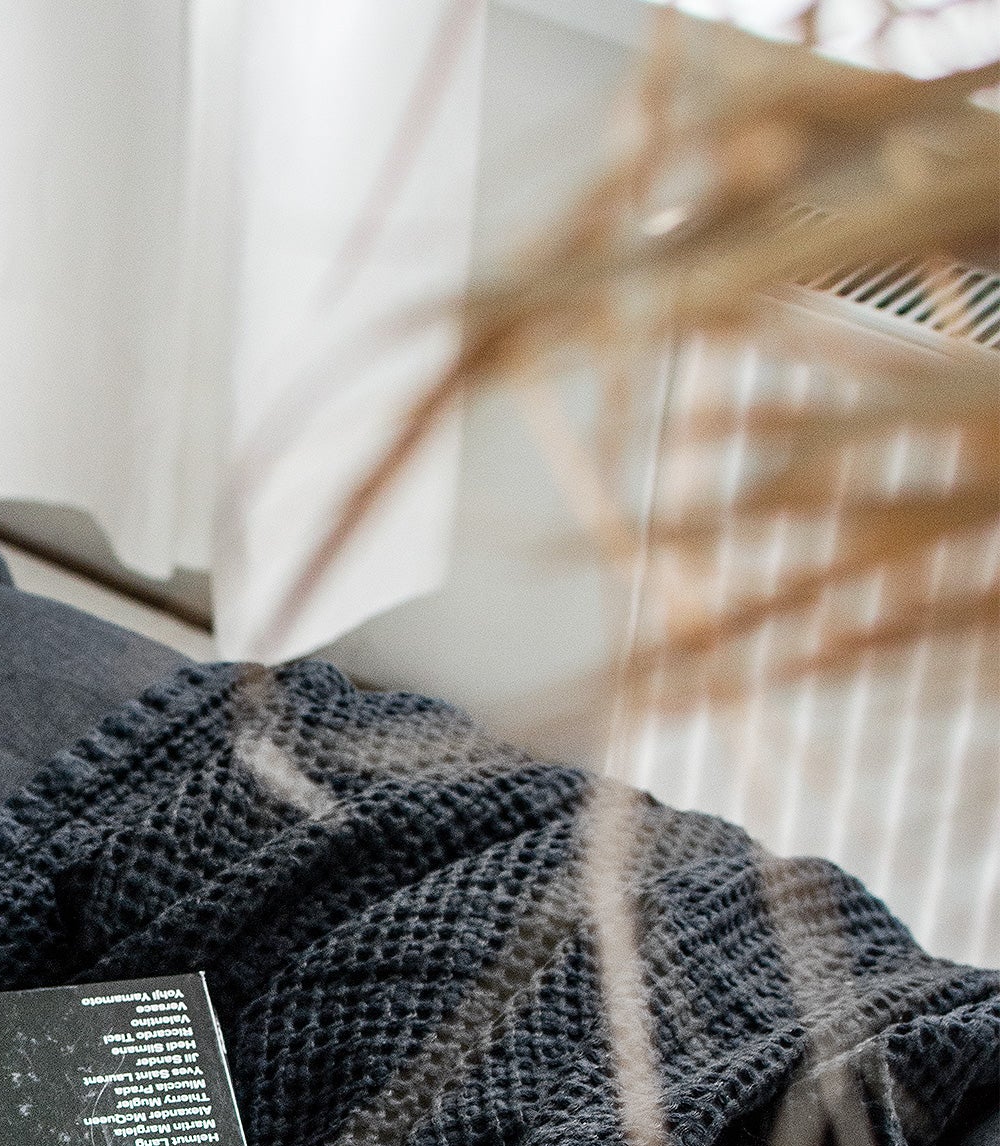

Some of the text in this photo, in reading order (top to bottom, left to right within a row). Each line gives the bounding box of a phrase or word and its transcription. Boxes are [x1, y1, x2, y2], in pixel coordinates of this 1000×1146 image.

[80, 988, 185, 1007] Yohji Yamamoto
[135, 1001, 188, 1014] Versace
[130, 1013, 192, 1028] Valentino
[102, 1026, 194, 1045] Riccardo Tisci
[110, 1039, 197, 1056] Hedi Slimane
[135, 1052, 200, 1067] Jil Sander
[82, 1065, 204, 1087] Yves Saint Laurent
[113, 1078, 207, 1097] Miuccia Prada
[115, 1092, 211, 1110] Thierry Mugler
[82, 1105, 213, 1126] Alexander McQueen
[112, 1118, 217, 1138] Martin Margiela
[170, 1132, 220, 1146] Helmut
